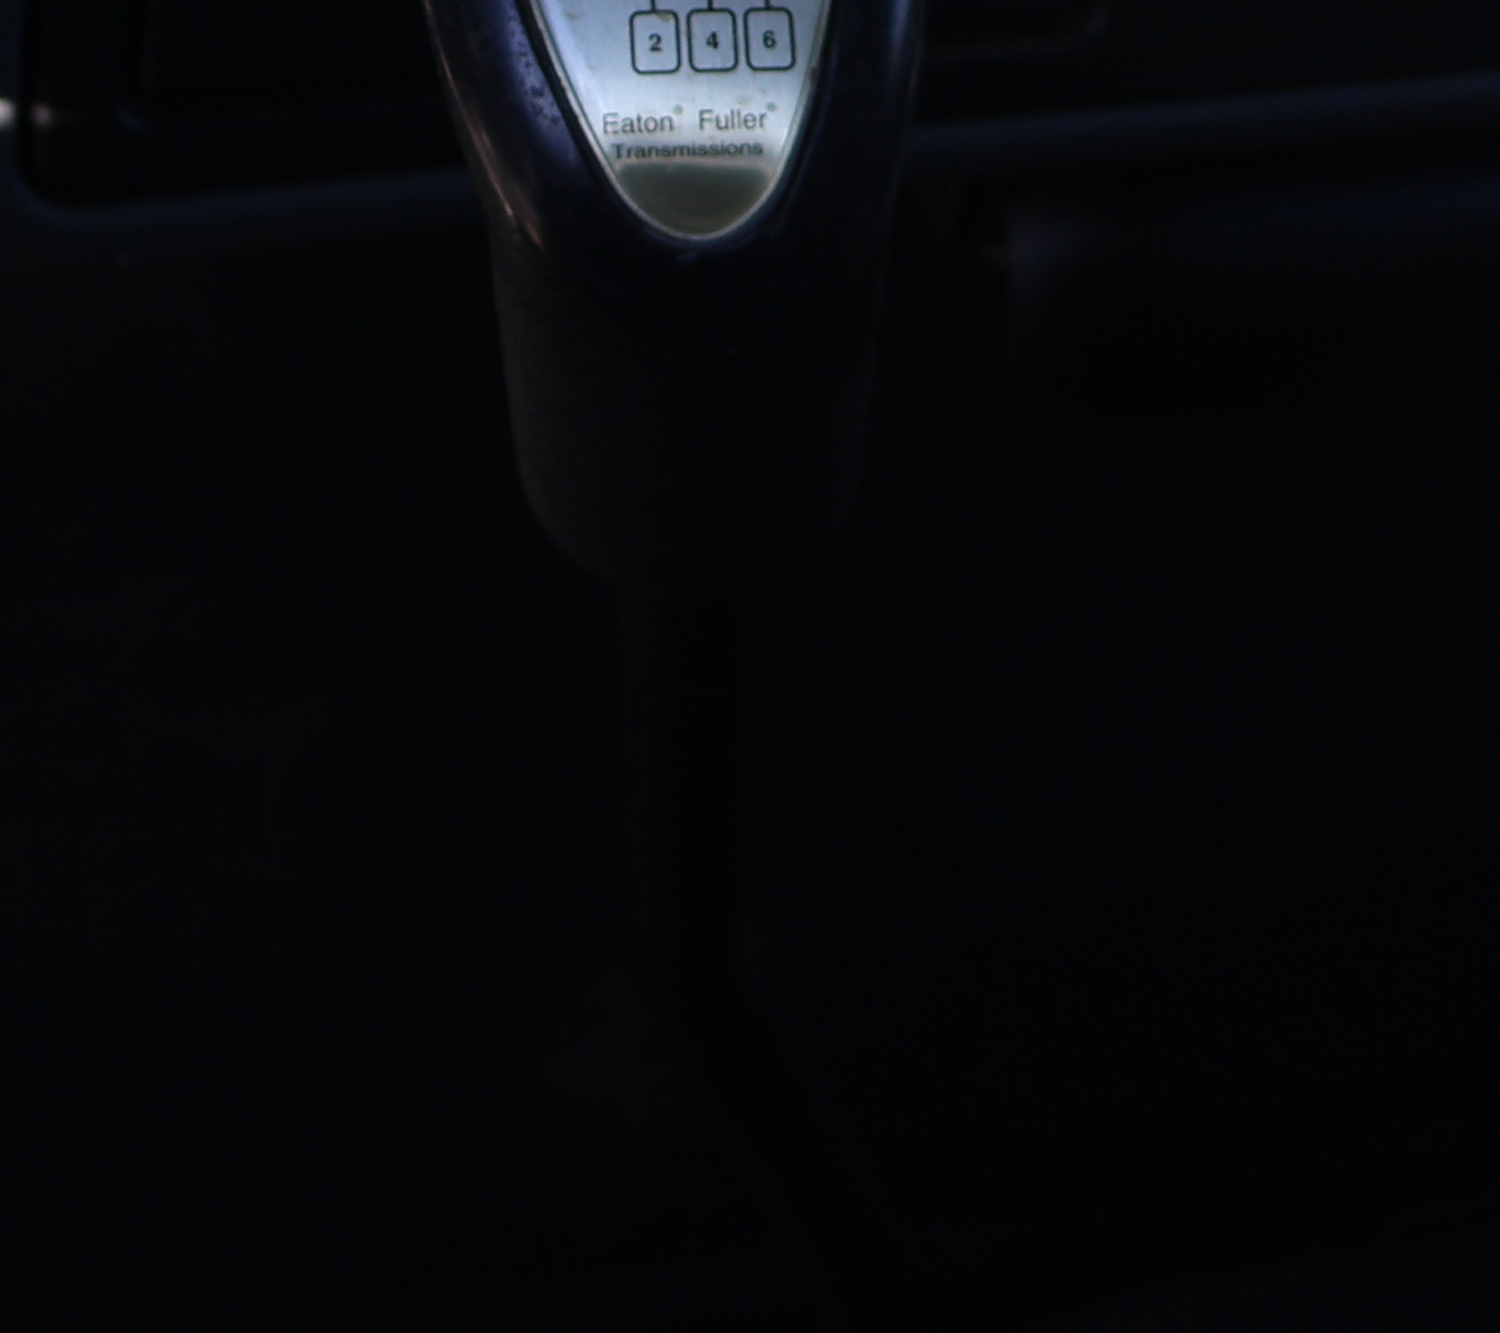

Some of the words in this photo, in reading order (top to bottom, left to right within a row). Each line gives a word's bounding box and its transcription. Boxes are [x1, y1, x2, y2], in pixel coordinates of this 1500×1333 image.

[649, 33, 663, 52] 2
[706, 31, 720, 49] 4
[762, 30, 777, 48] 6
[611, 140, 764, 160] Transmissions
